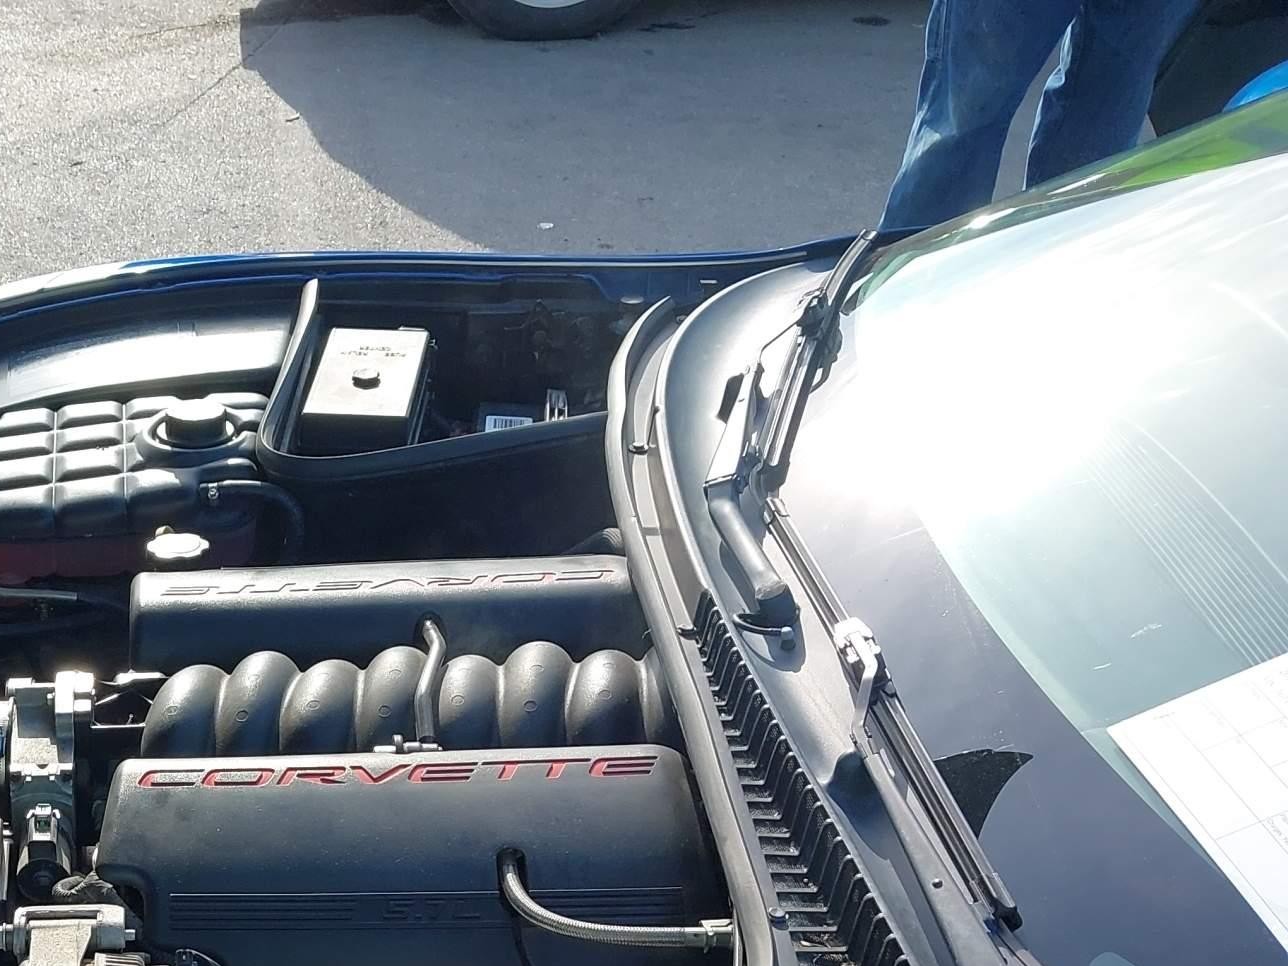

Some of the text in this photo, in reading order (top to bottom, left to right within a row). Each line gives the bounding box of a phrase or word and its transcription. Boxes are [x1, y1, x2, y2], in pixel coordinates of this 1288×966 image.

[159, 568, 616, 597] CORVETTE
[137, 755, 659, 788] CORVETTE
[382, 898, 481, 920] 5.7L
